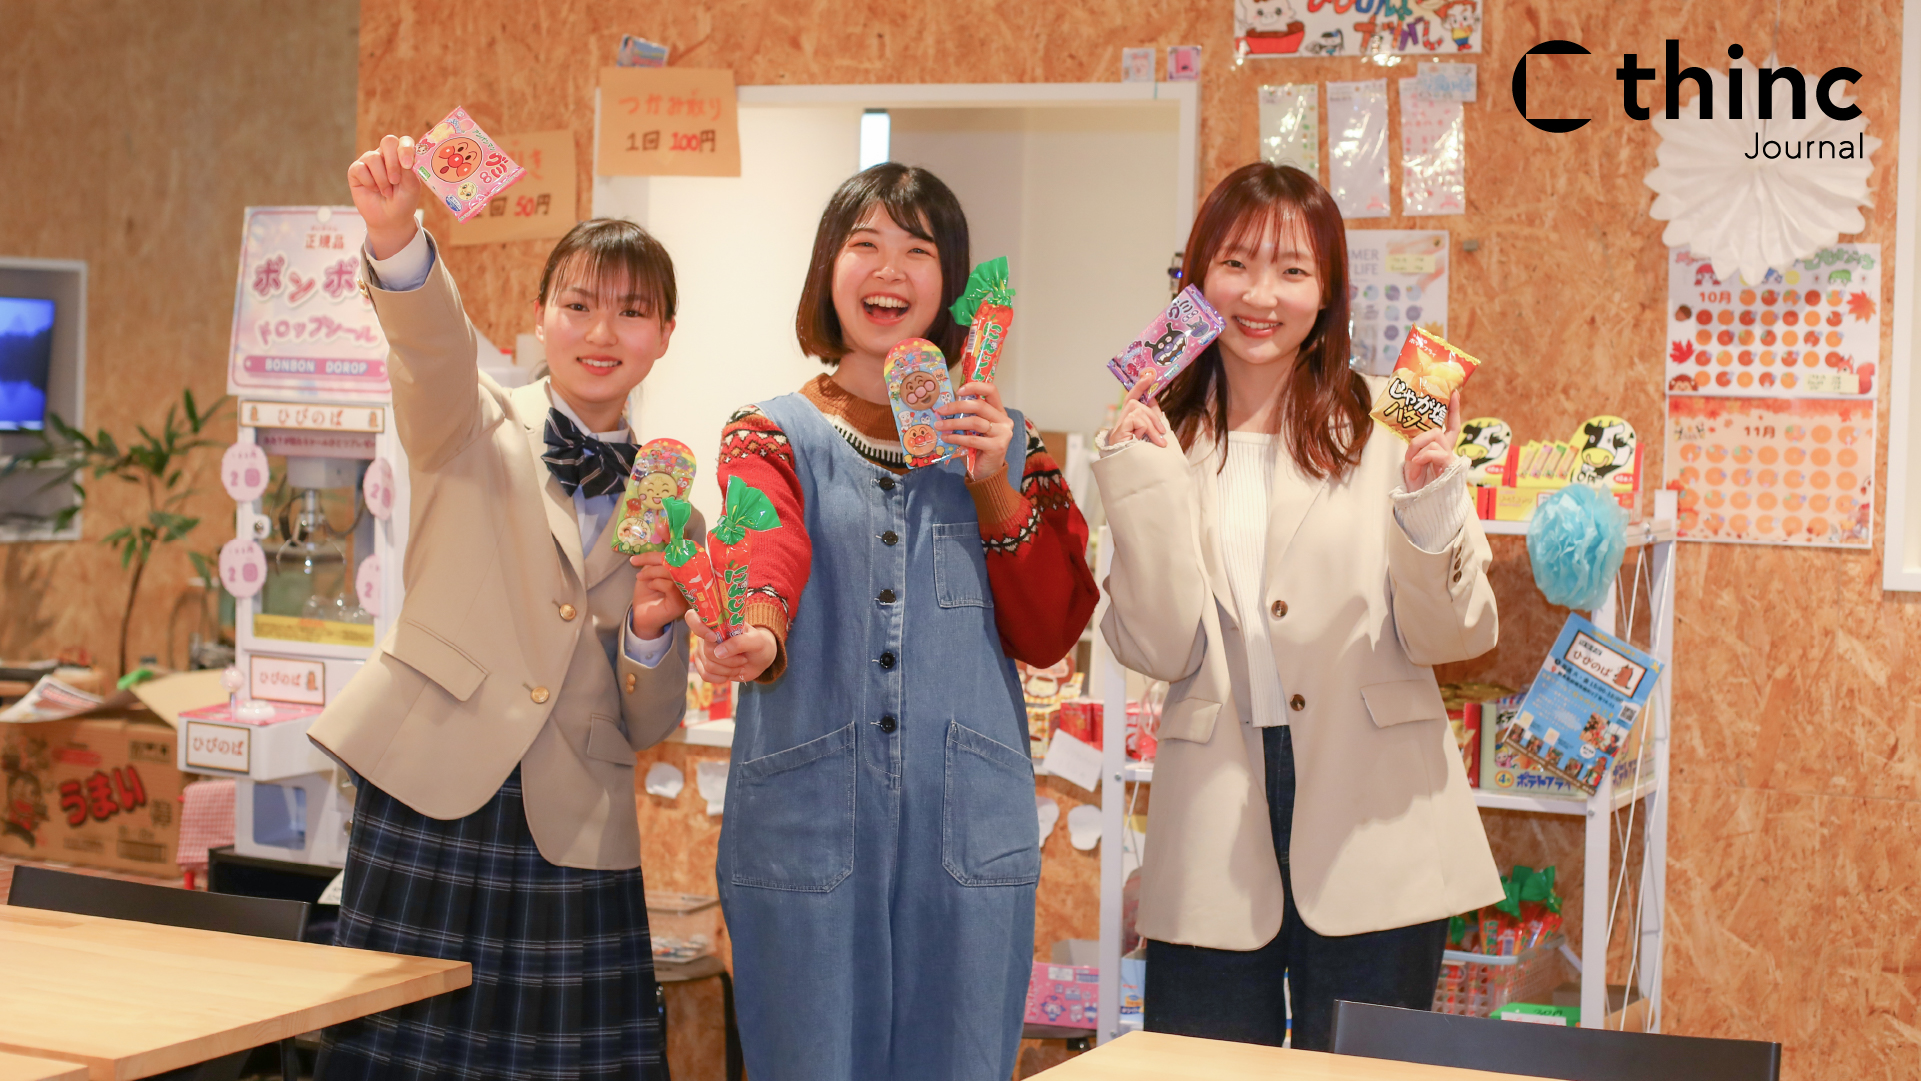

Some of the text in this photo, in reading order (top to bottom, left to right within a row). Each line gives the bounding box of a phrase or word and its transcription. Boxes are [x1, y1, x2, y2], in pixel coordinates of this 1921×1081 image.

[625, 129, 716, 152] 1回 100円
[485, 152, 509, 180] グミ
[514, 193, 551, 218] 50円
[305, 232, 344, 249] 正規品
[1348, 248, 1379, 261] MER
[252, 254, 372, 305] ボンボ
[1353, 263, 1379, 276] LIFE
[1699, 290, 1732, 305] 10月
[1167, 298, 1194, 320] グミ
[1408, 337, 1437, 358] ポテフライ
[264, 359, 367, 375] BONBON DOROP
[1389, 378, 1448, 428] じゃが塩
[277, 406, 344, 426] ひびのば
[1383, 401, 1433, 432] バター
[1744, 425, 1776, 439] 11月
[1573, 650, 1613, 678] ひびのば
[259, 669, 302, 687] ひびのば
[192, 736, 244, 757] ひびのば
[60, 764, 147, 828] うまい
